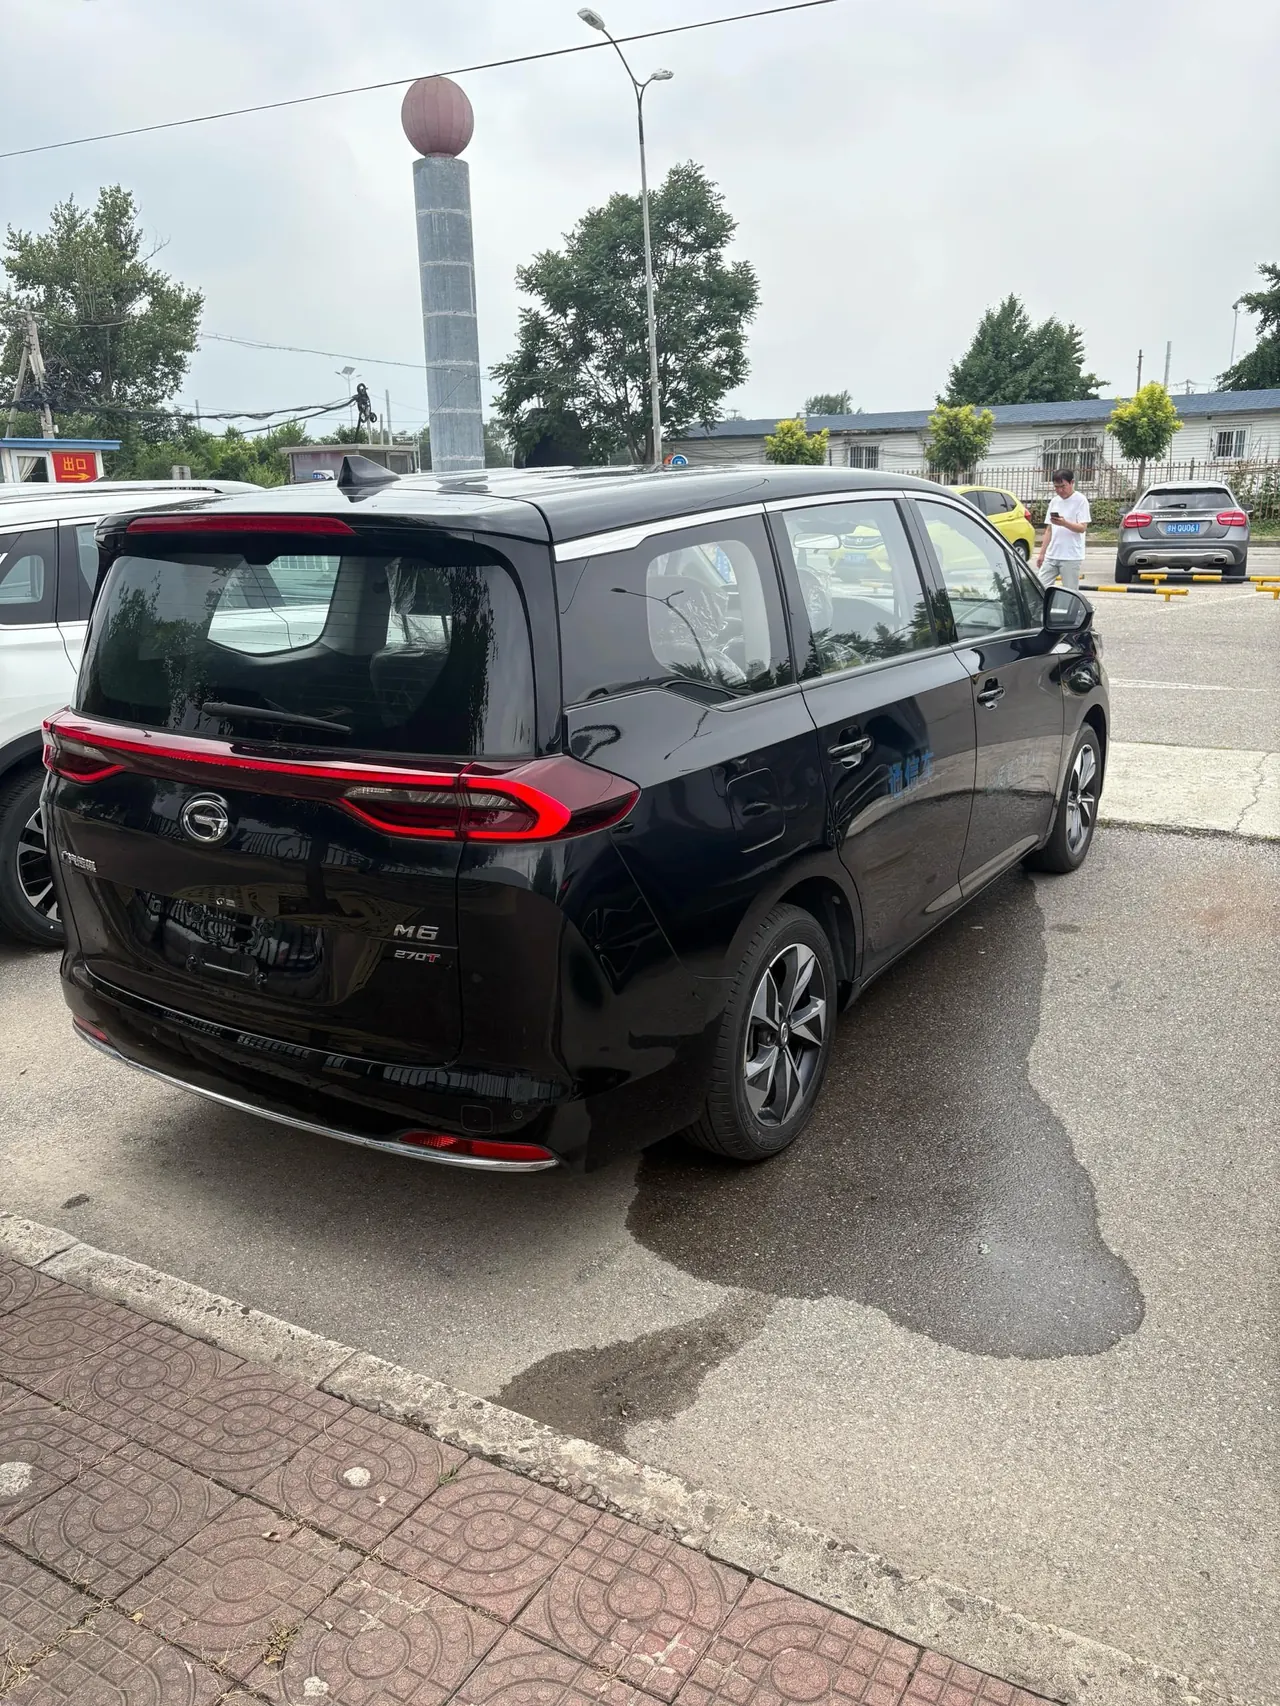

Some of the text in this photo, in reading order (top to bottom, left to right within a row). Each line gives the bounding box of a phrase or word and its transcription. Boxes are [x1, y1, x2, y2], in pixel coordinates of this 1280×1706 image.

[63, 456, 87, 471] 出口
[393, 924, 440, 940] M6
[394, 949, 441, 963] 270T
